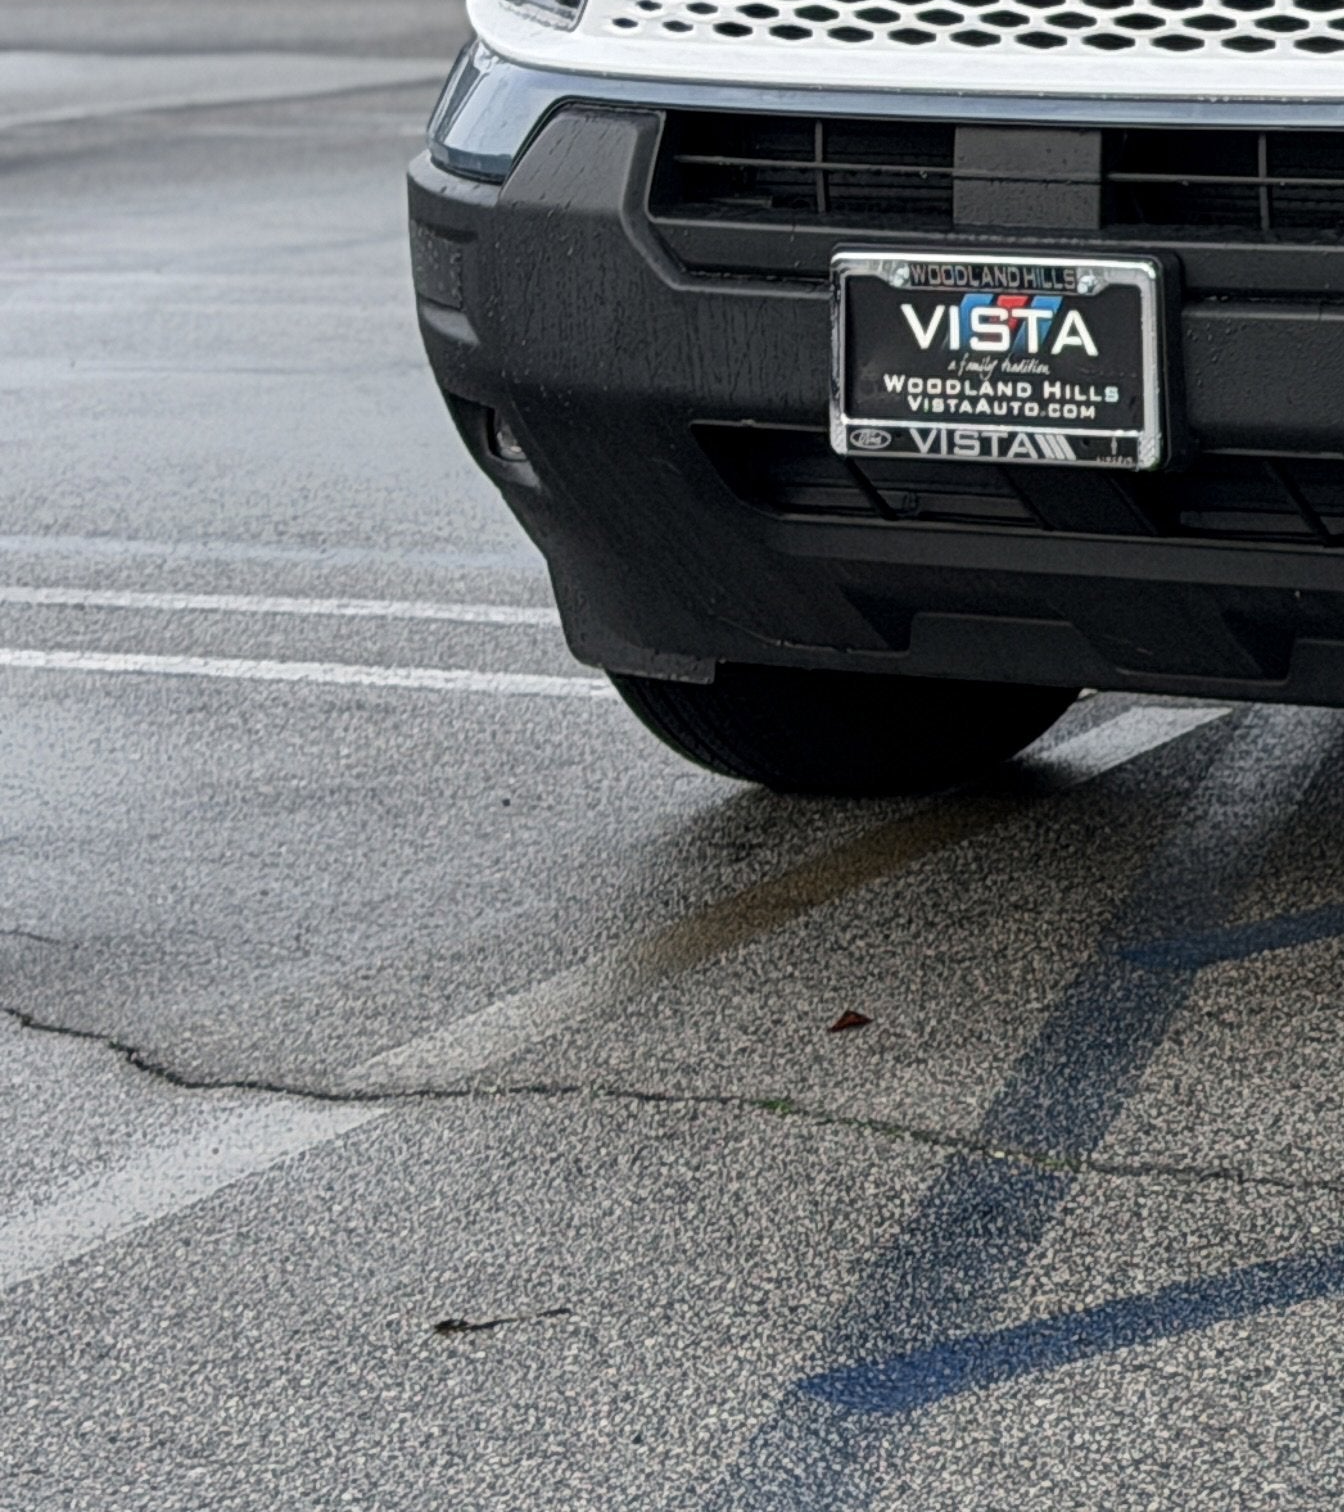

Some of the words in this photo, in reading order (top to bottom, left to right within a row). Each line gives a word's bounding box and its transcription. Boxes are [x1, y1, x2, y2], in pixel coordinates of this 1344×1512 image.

[911, 265, 1020, 288] WOODLAND
[1022, 268, 1077, 289] HILLS
[901, 303, 1099, 357] VISTA
[908, 427, 1039, 459] VISTA
